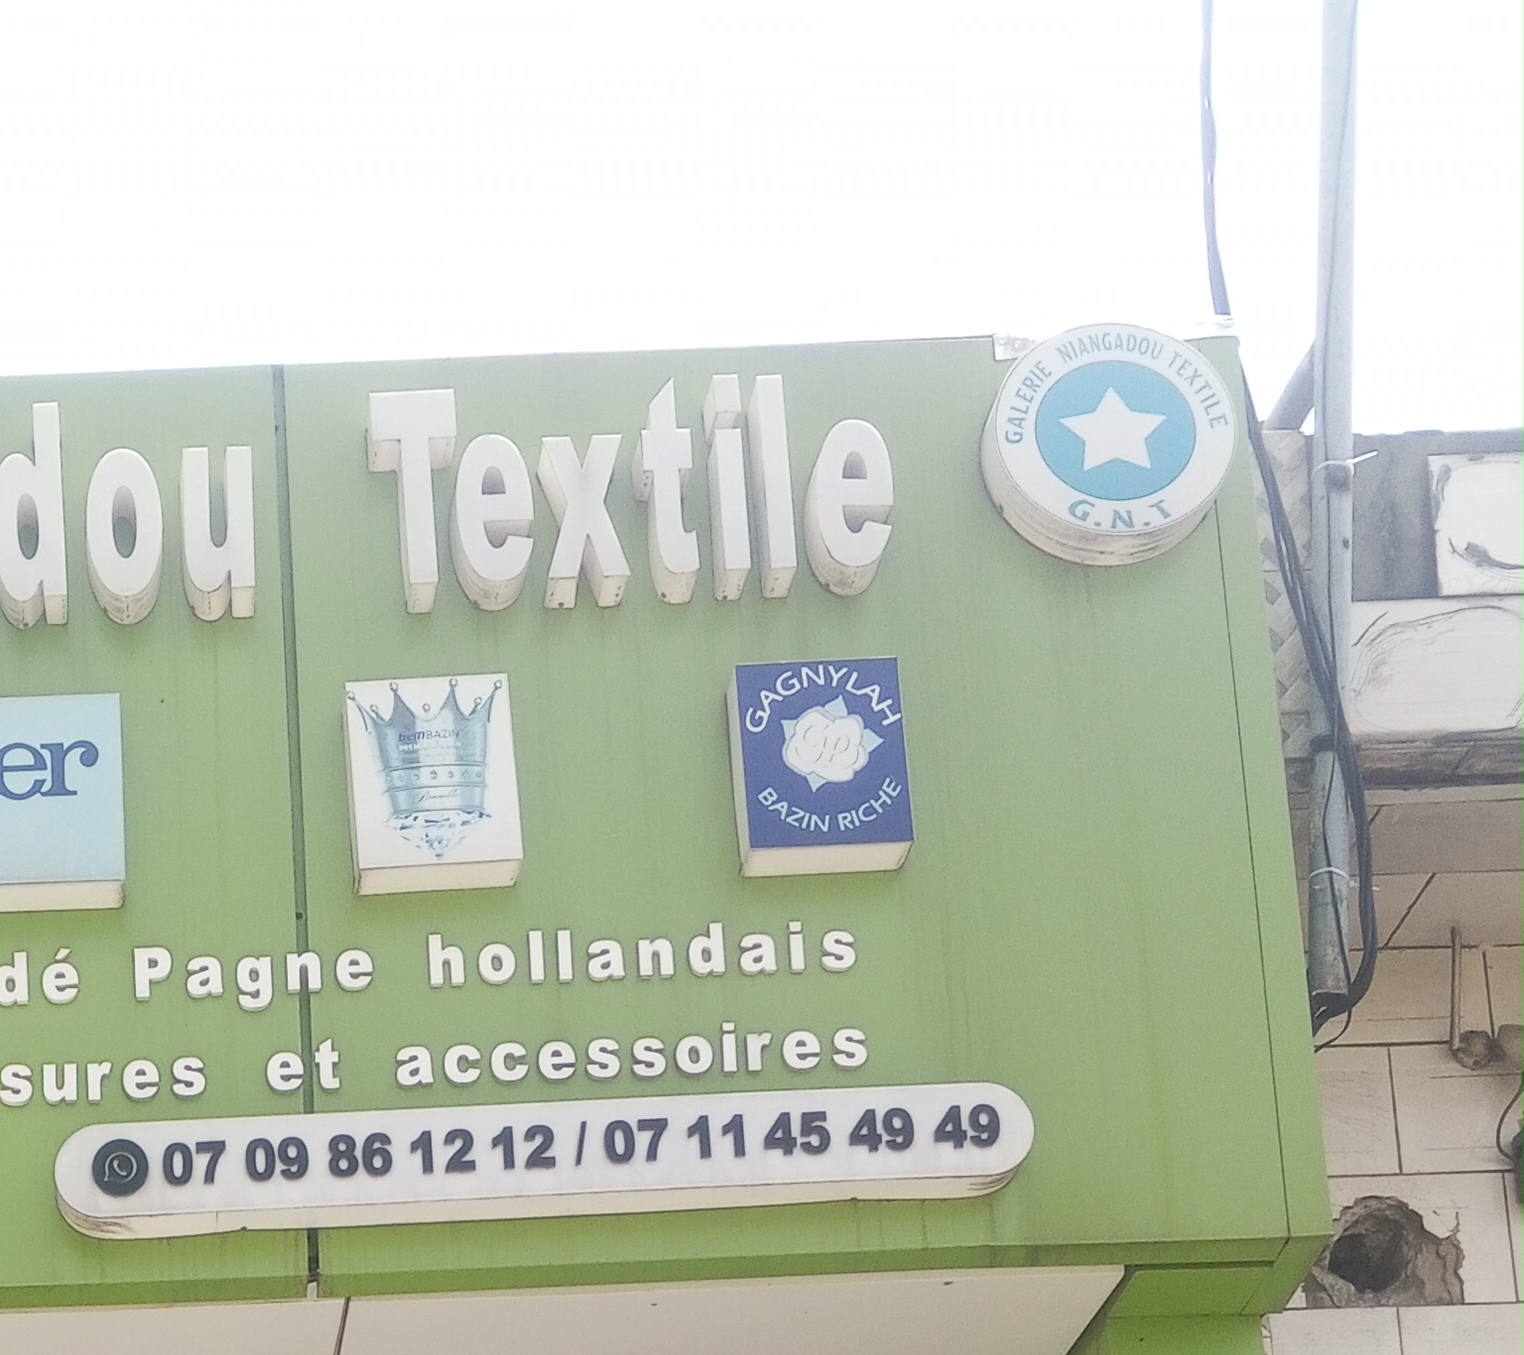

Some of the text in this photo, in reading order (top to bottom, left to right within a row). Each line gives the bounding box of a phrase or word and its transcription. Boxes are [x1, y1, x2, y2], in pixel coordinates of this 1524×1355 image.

[1004, 332, 1229, 444] GALERIE NIANGADOU TEXTILE
[367, 374, 893, 605] Textile
[745, 664, 902, 733] GAGNYLAH
[757, 777, 902, 832] BAZIN RICHE
[133, 945, 376, 1011] Pagne
[427, 920, 860, 988] hollandais
[266, 1038, 342, 1093] et
[395, 1020, 871, 1088] accessoires
[161, 1140, 226, 1187] 07
[244, 1137, 310, 1184] 09
[328, 1132, 394, 1180] 86
[411, 1128, 477, 1176] 12
[491, 1124, 557, 1172] 12
[603, 1117, 668, 1164] 07
[687, 1114, 746, 1160] 11
[763, 1109, 832, 1157] 45
[849, 1106, 916, 1154] 49
[934, 1103, 1002, 1151] 49
